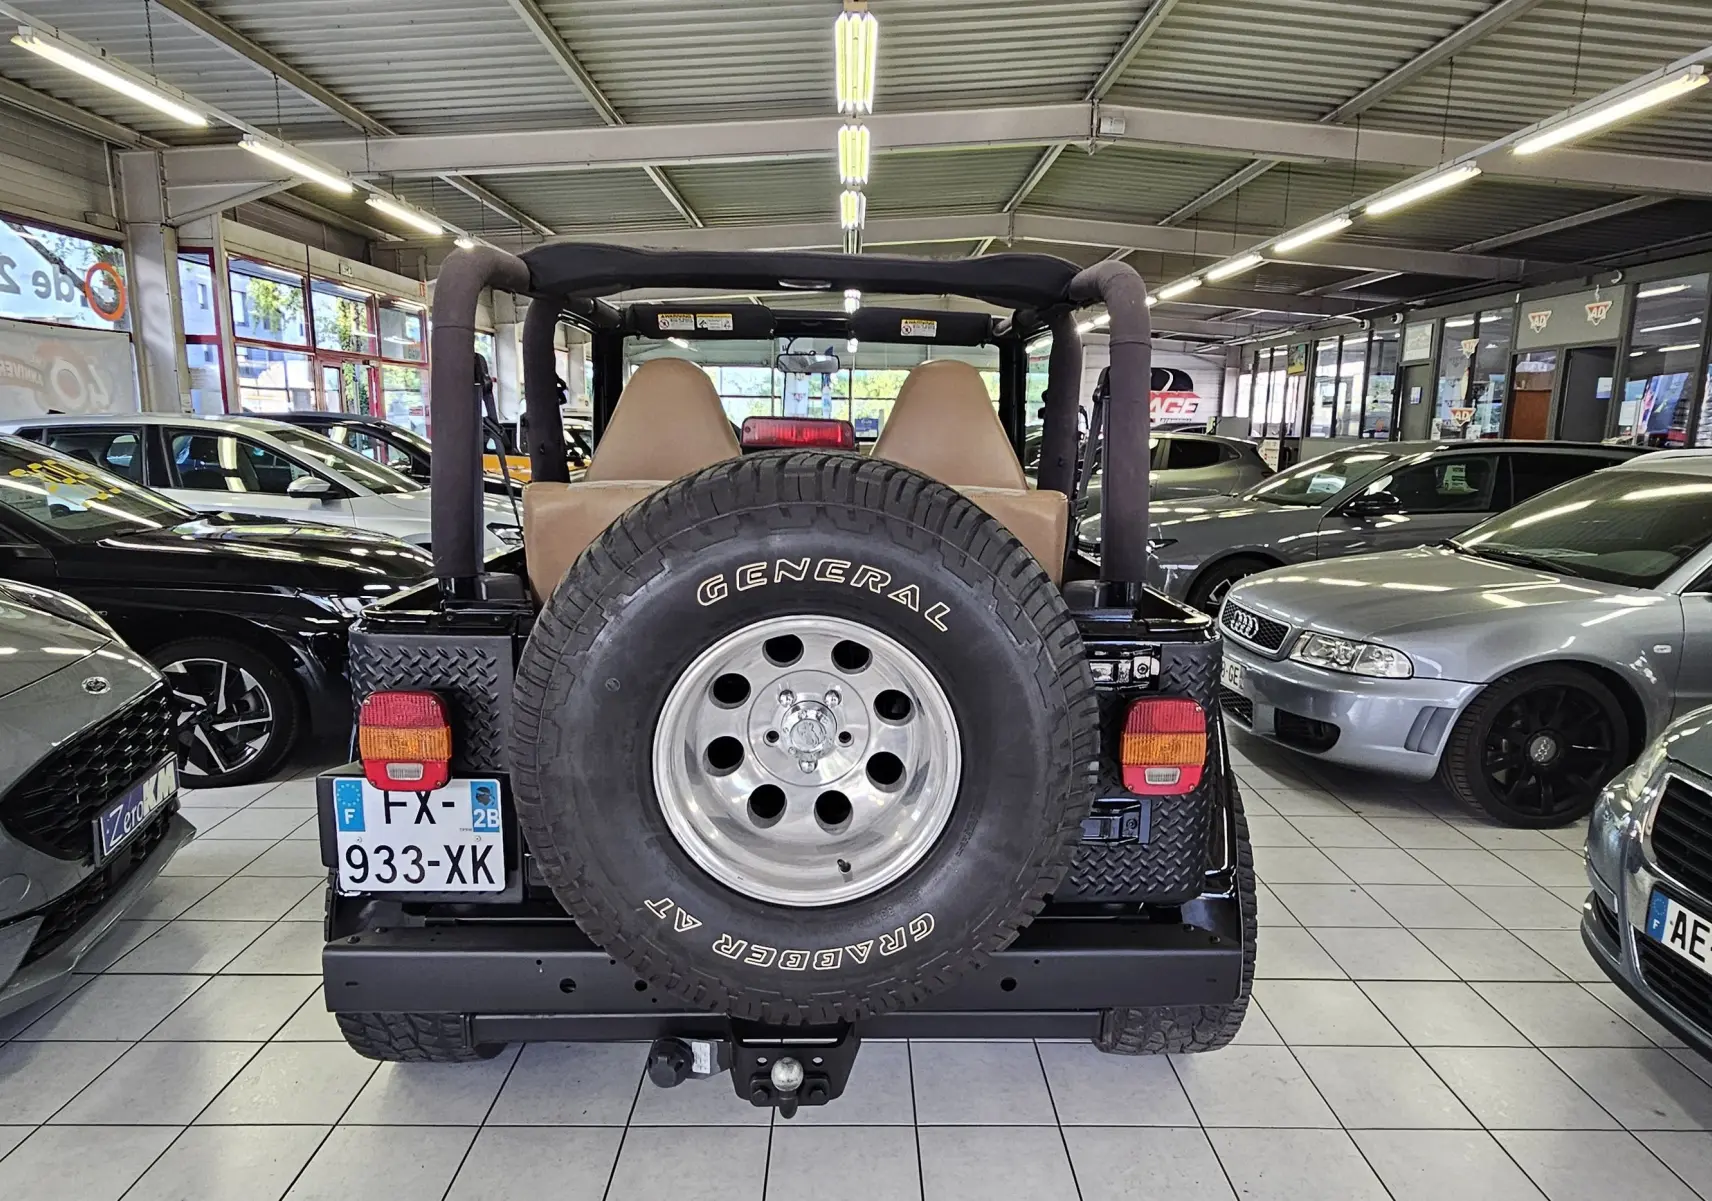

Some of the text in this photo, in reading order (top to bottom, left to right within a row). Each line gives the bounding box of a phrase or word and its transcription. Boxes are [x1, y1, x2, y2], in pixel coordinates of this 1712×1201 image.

[696, 557, 951, 633] GENERAL
[143, 761, 176, 816] KM
[344, 808, 356, 825] F
[473, 809, 500, 828] 2B
[345, 844, 496, 885] 933-XK
[644, 897, 935, 971] GRABBER AT
[1652, 918, 1661, 930] F
